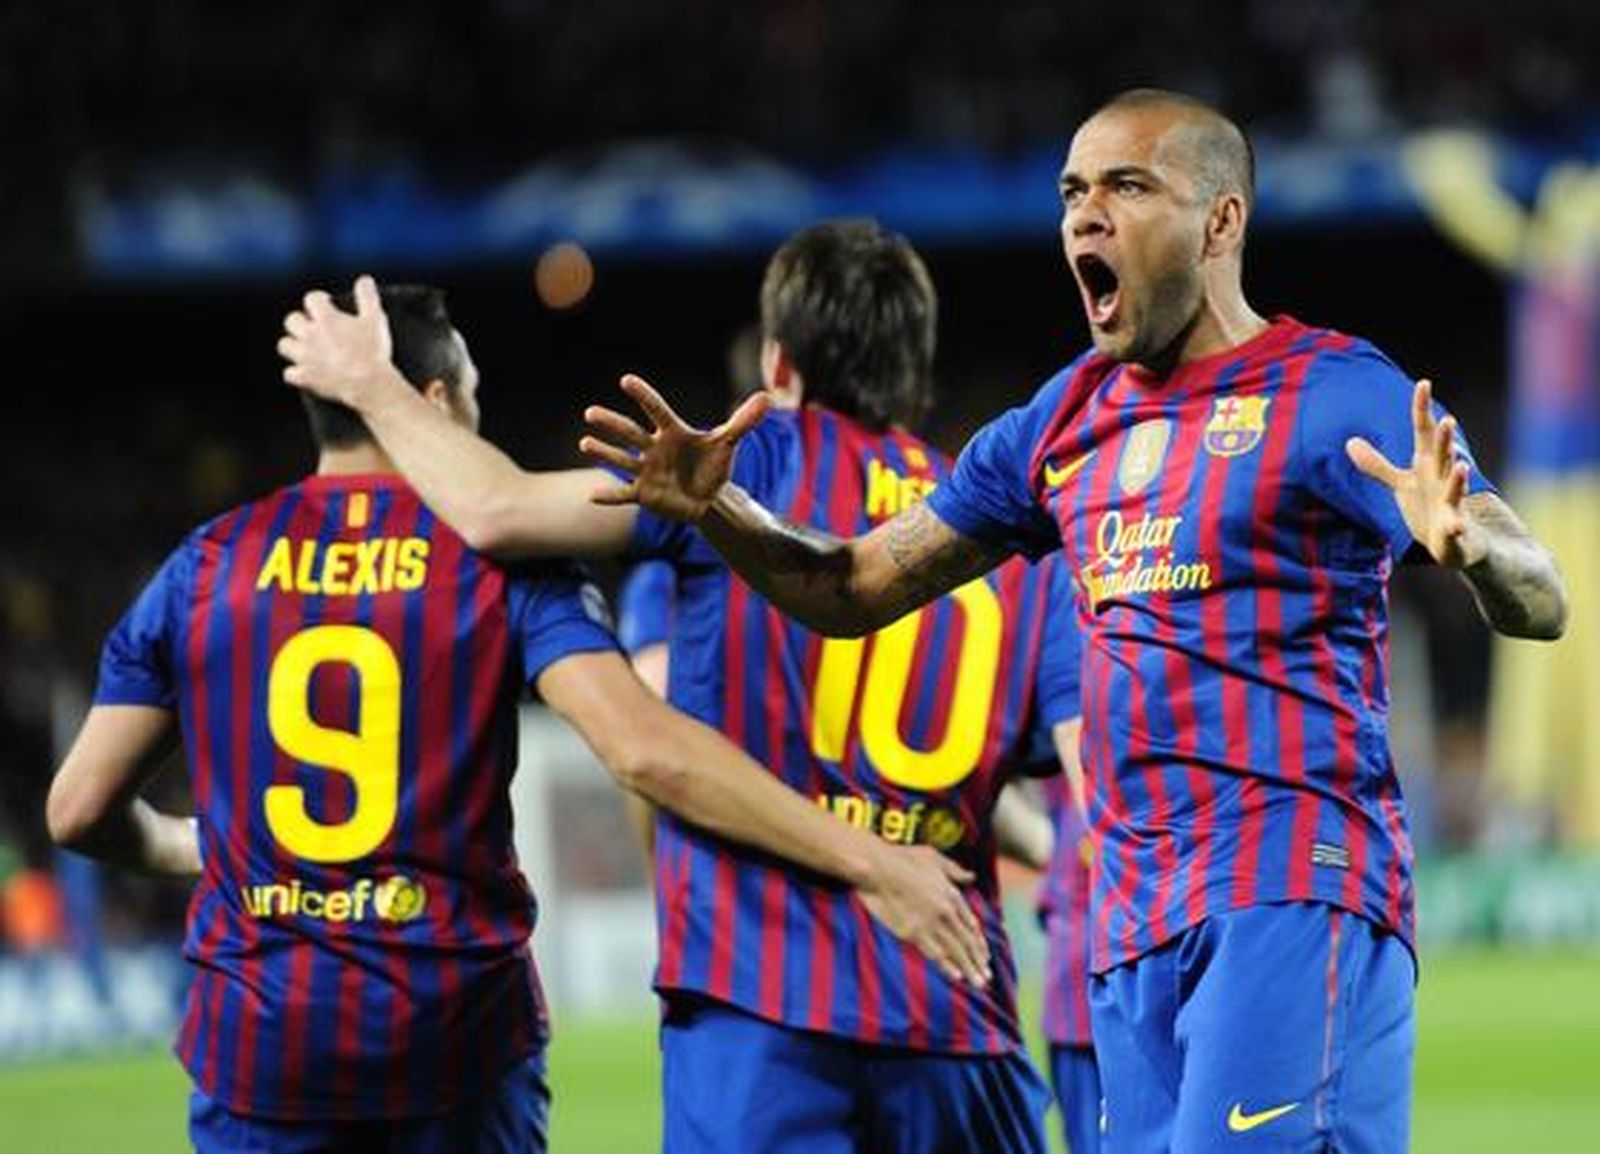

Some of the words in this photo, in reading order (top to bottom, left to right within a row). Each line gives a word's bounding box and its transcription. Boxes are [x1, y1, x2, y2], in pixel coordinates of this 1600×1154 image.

[257, 537, 430, 595] ALEXIS
[1096, 511, 1183, 568] Qatar
[1081, 553, 1212, 610] undation
[812, 578, 1002, 790] 10
[264, 624, 401, 863] 9
[817, 794, 926, 844] nief
[241, 879, 372, 921] unicef
